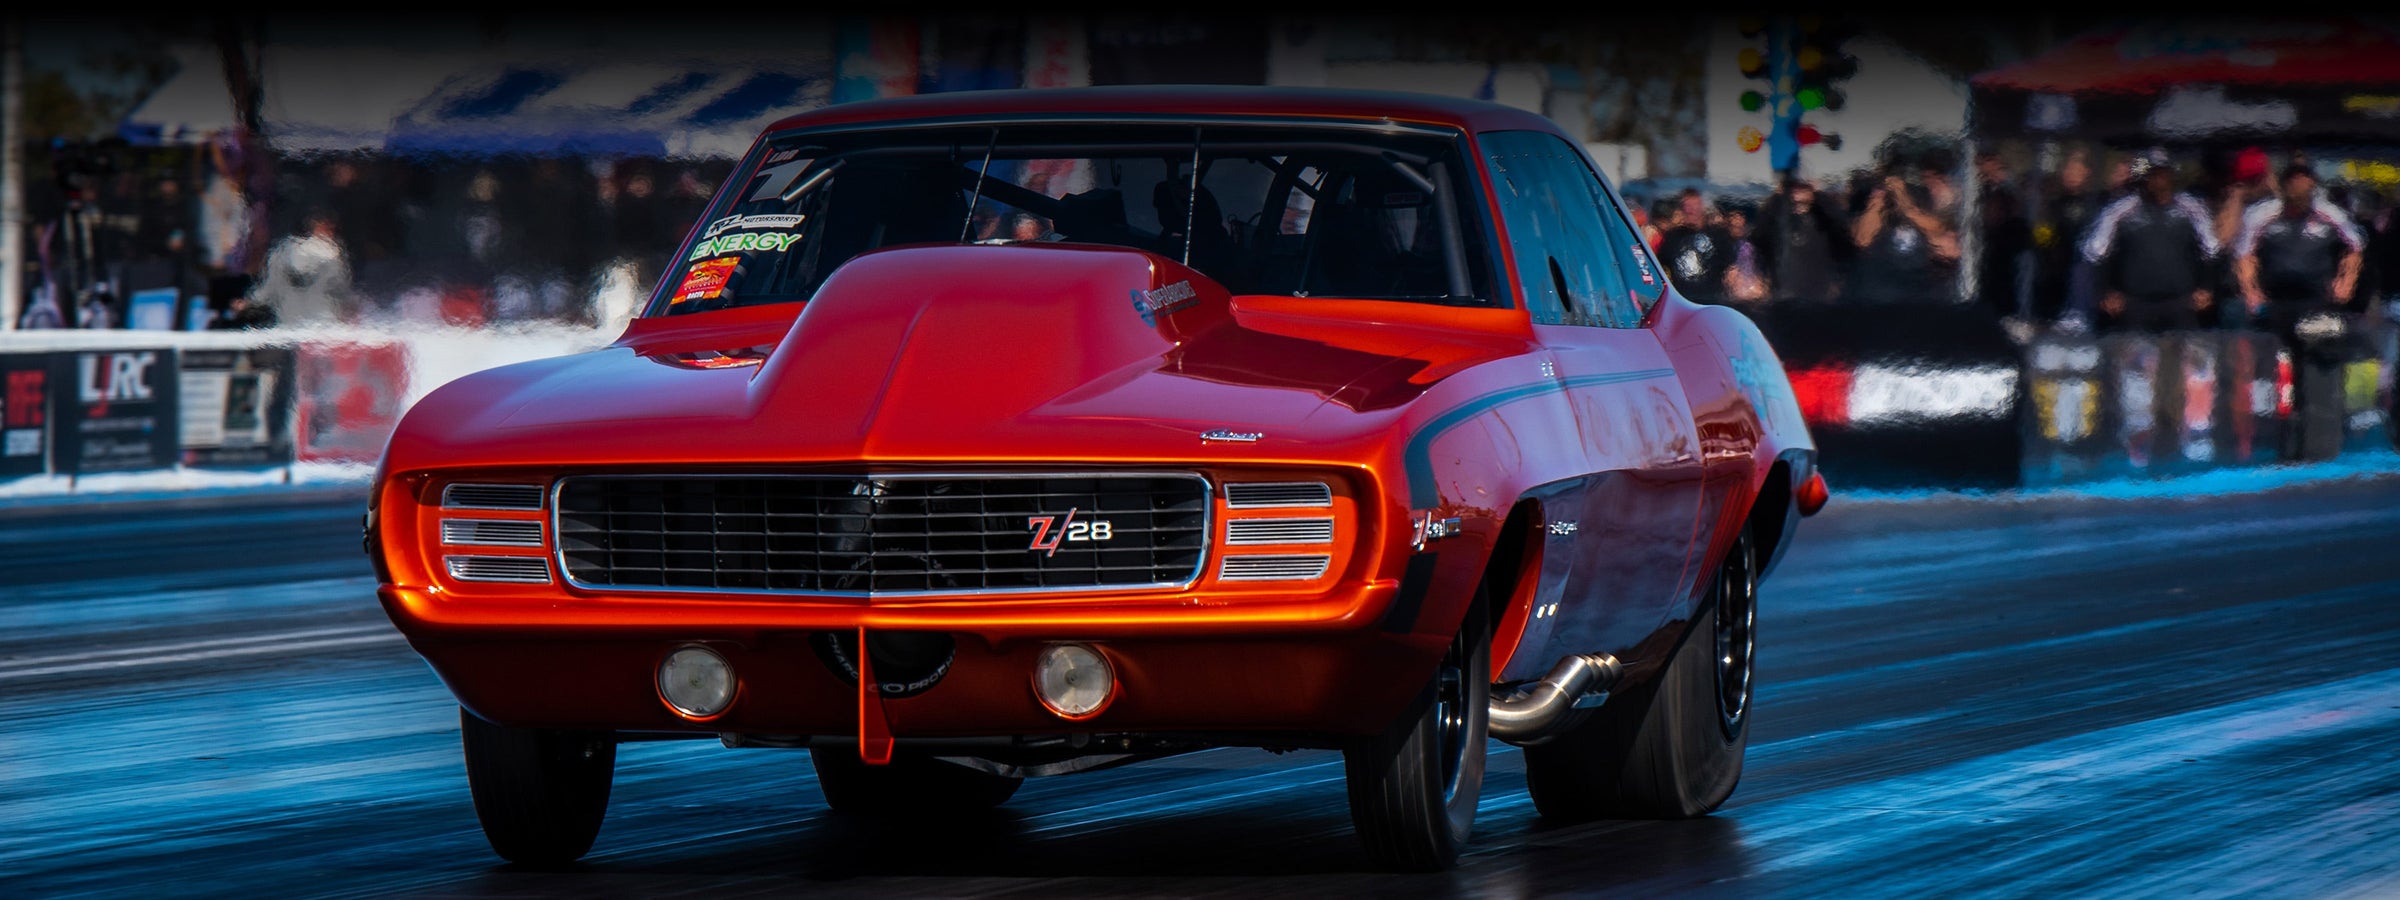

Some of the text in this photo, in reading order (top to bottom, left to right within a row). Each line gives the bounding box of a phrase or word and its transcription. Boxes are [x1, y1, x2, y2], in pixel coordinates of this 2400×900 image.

[749, 158, 815, 201] 1
[690, 233, 802, 261] ENERGY
[1028, 507, 1113, 557] Z/28
